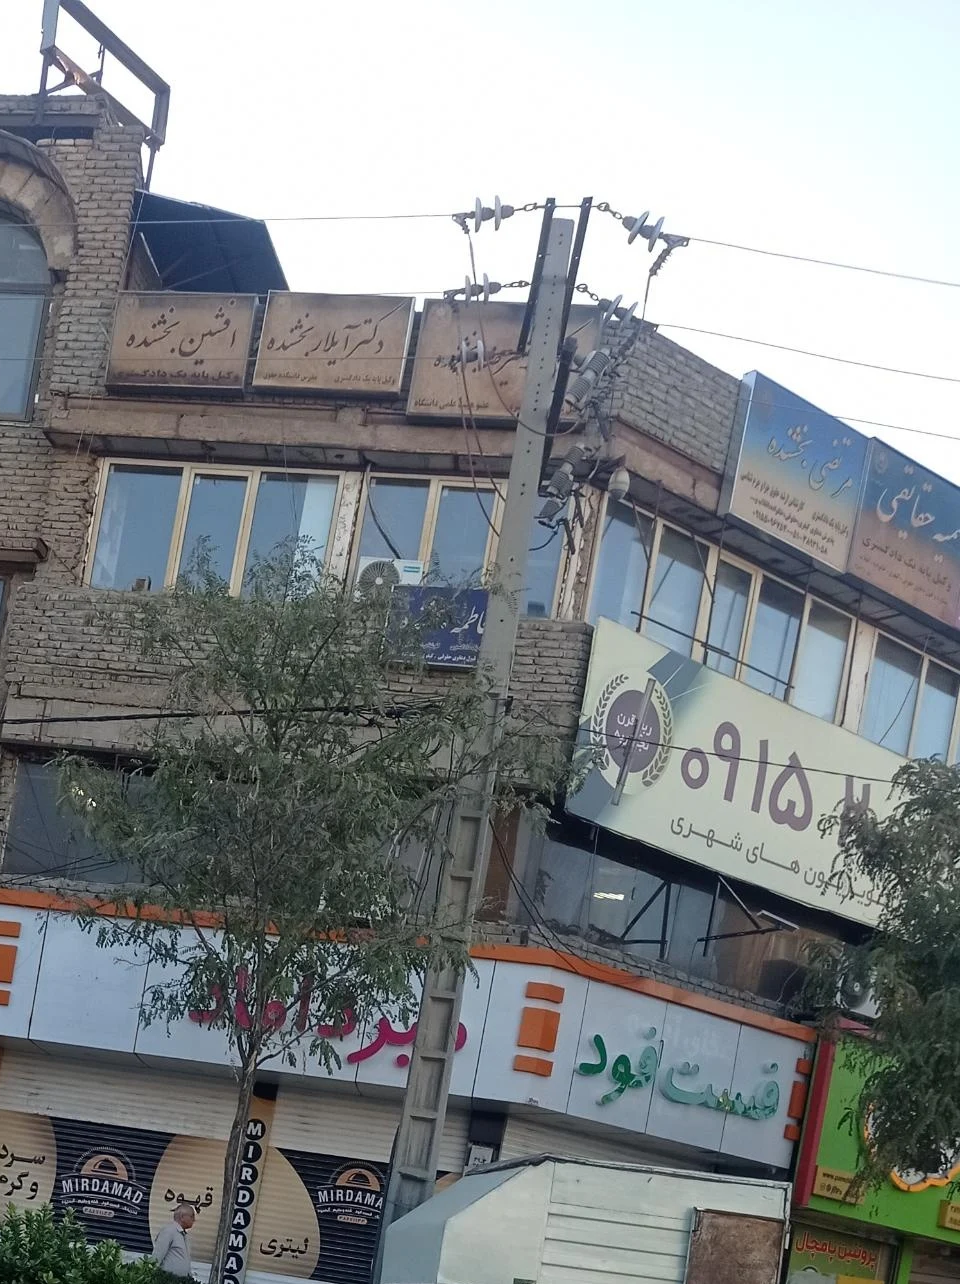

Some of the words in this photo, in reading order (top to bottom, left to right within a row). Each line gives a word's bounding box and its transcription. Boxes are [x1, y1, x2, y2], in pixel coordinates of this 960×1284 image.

[126, 306, 180, 354] بخشنده
[179, 299, 237, 365] افشین
[267, 312, 314, 356] بخشنده
[311, 322, 361, 366] آیلار
[344, 299, 410, 360] دکتر
[115, 369, 167, 379] دادگستری
[170, 369, 187, 378] یک
[192, 370, 208, 379] پایه
[212, 370, 239, 380] وکیل
[767, 424, 813, 470] بخشنده
[876, 464, 935, 540] حقایقی
[449, 605, 485, 635] اطمه
[681, 721, 813, 832] ۰۹۱۵
[670, 816, 743, 852] شهری
[745, 843, 800, 875] های
[188, 964, 468, 1068] یرداماد
[576, 1025, 658, 1107] فود
[660, 1061, 780, 1121] فست
[25, 1181, 39, 1200] و
[61, 1178, 144, 1204] MIRDAMAD
[164, 1186, 214, 1214] قهوه
[317, 1189, 384, 1209] MIRDAMA
[795, 1230, 837, 1263] پامچال
[838, 1244, 878, 1268] پروتئین
